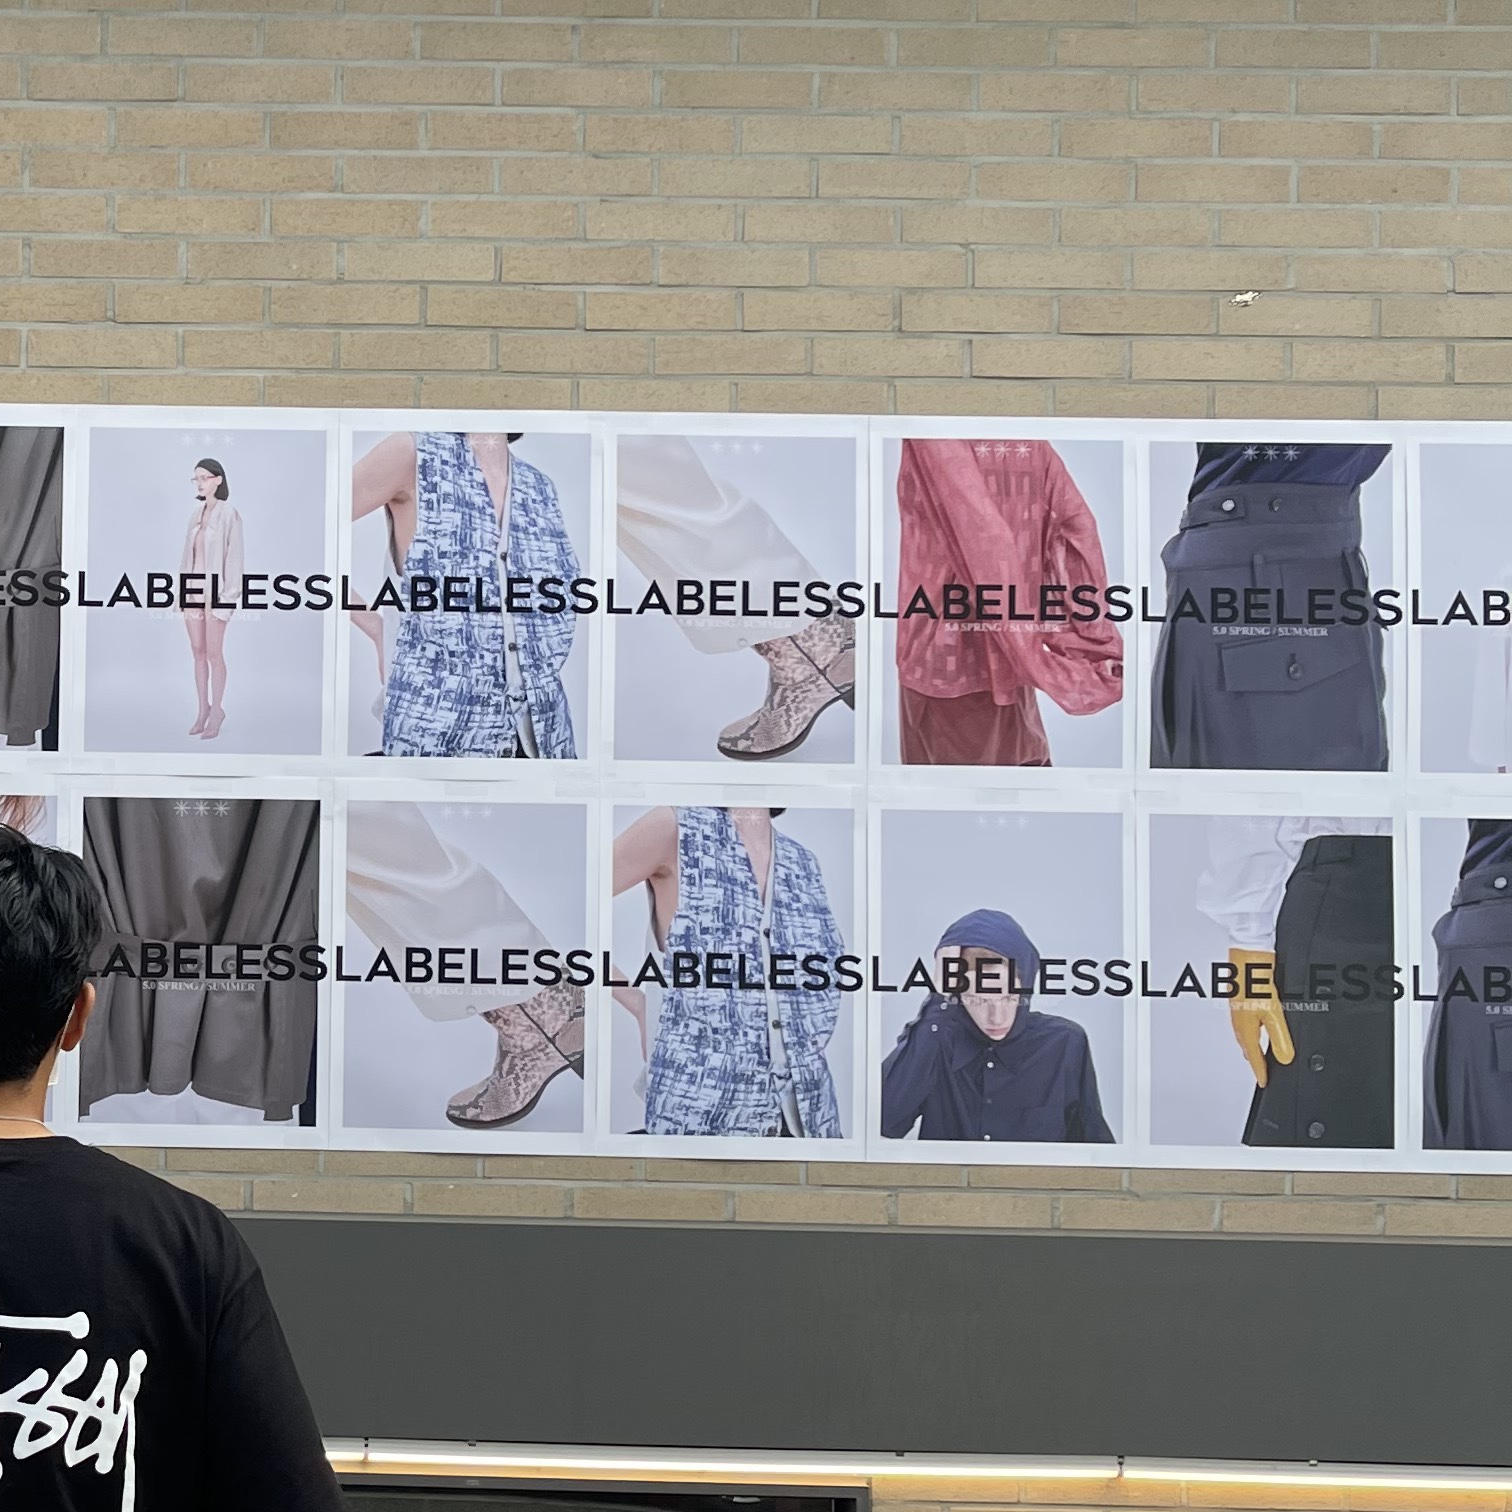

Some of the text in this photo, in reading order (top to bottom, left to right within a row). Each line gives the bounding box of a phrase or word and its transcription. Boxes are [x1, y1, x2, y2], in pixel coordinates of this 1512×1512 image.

[77, 571, 333, 611] LABELESS
[341, 574, 598, 614] LABELESS
[606, 578, 865, 618] LABELESS
[874, 582, 1133, 622] LABELESS
[1141, 586, 1403, 626] LABELESS
[960, 623, 1001, 632] SPRING
[1212, 626, 1226, 635] 5.0
[1228, 626, 1271, 636] SPRING
[1278, 627, 1329, 637] SUMMER
[85, 942, 328, 981] ABELESS
[336, 946, 594, 986] LABELESS
[603, 951, 863, 991] LABELESS
[872, 956, 1133, 997] LABELESS
[1141, 961, 1404, 1002] LABELESS
[142, 981, 155, 990] 5.0
[158, 981, 199, 991] SPRING
[206, 982, 255, 991] SUMMER
[1281, 1002, 1329, 1011] SUMMER
